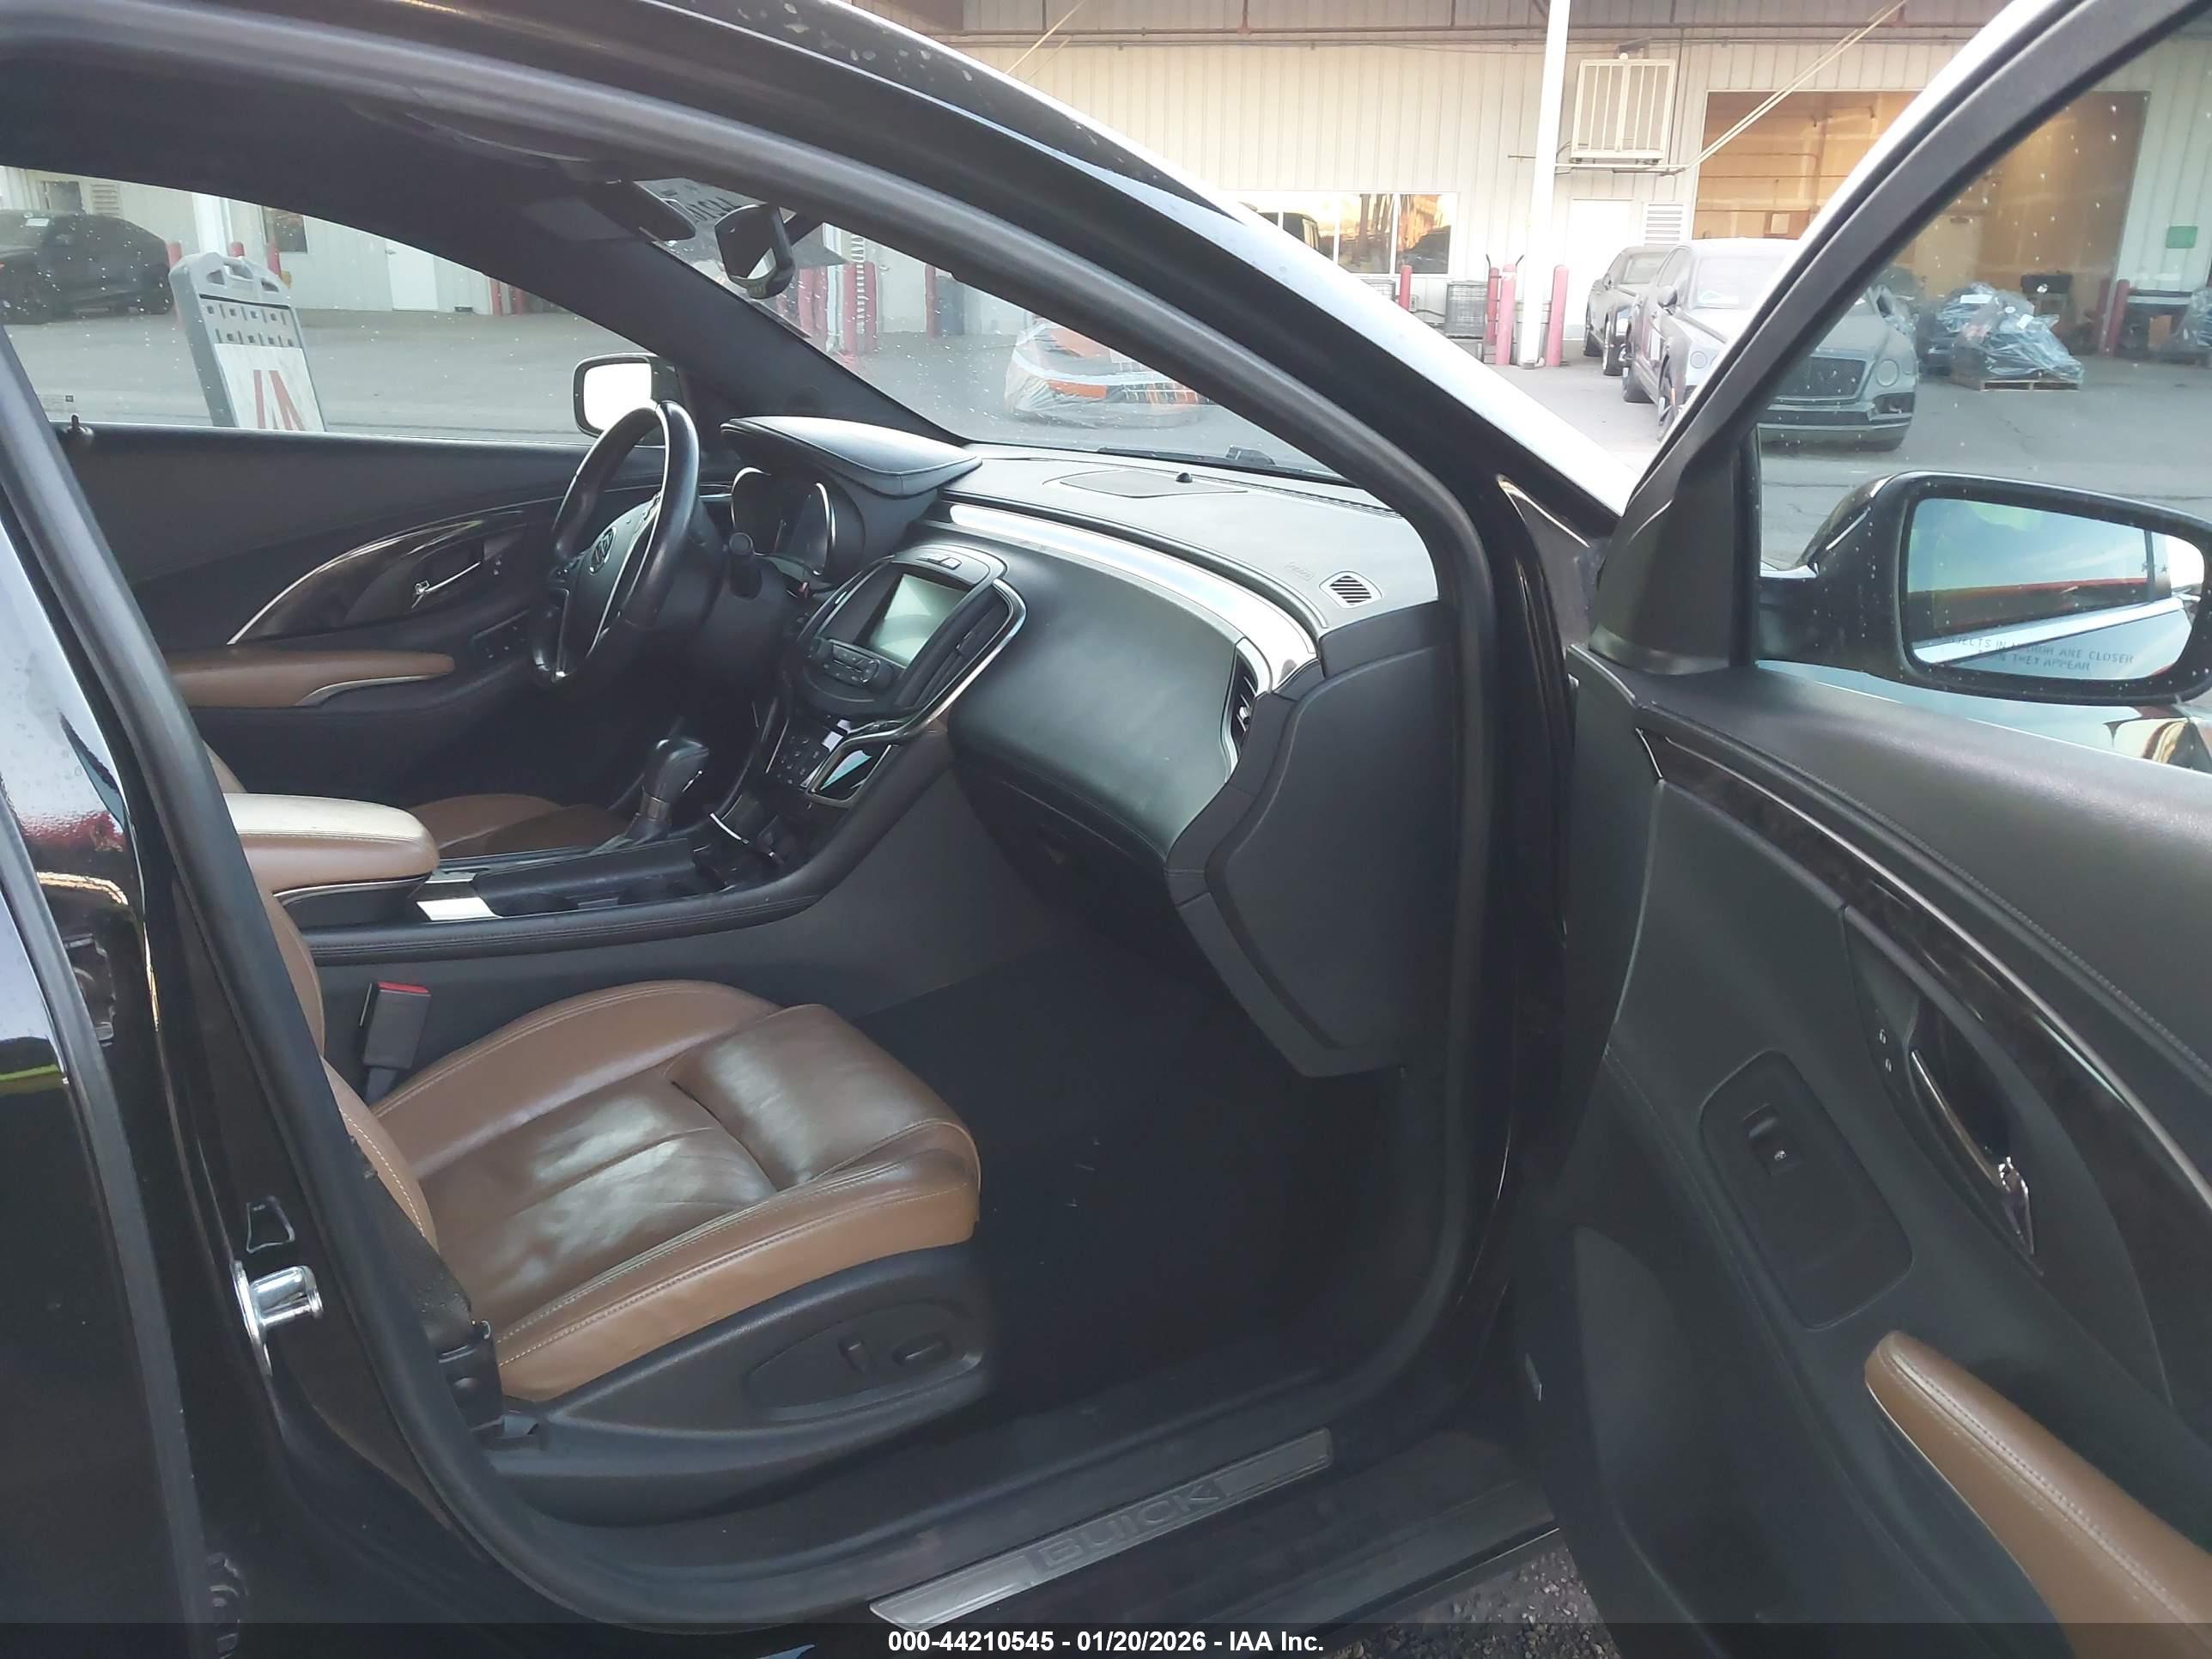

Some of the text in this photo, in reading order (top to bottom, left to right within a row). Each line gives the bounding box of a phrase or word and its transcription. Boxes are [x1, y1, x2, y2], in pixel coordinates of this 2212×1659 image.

[2060, 647, 2082, 659] ARE
[2088, 650, 2135, 664] CLOSER
[2044, 658, 2091, 672] APPEAR
[1037, 1484, 1221, 1568] BUICK
